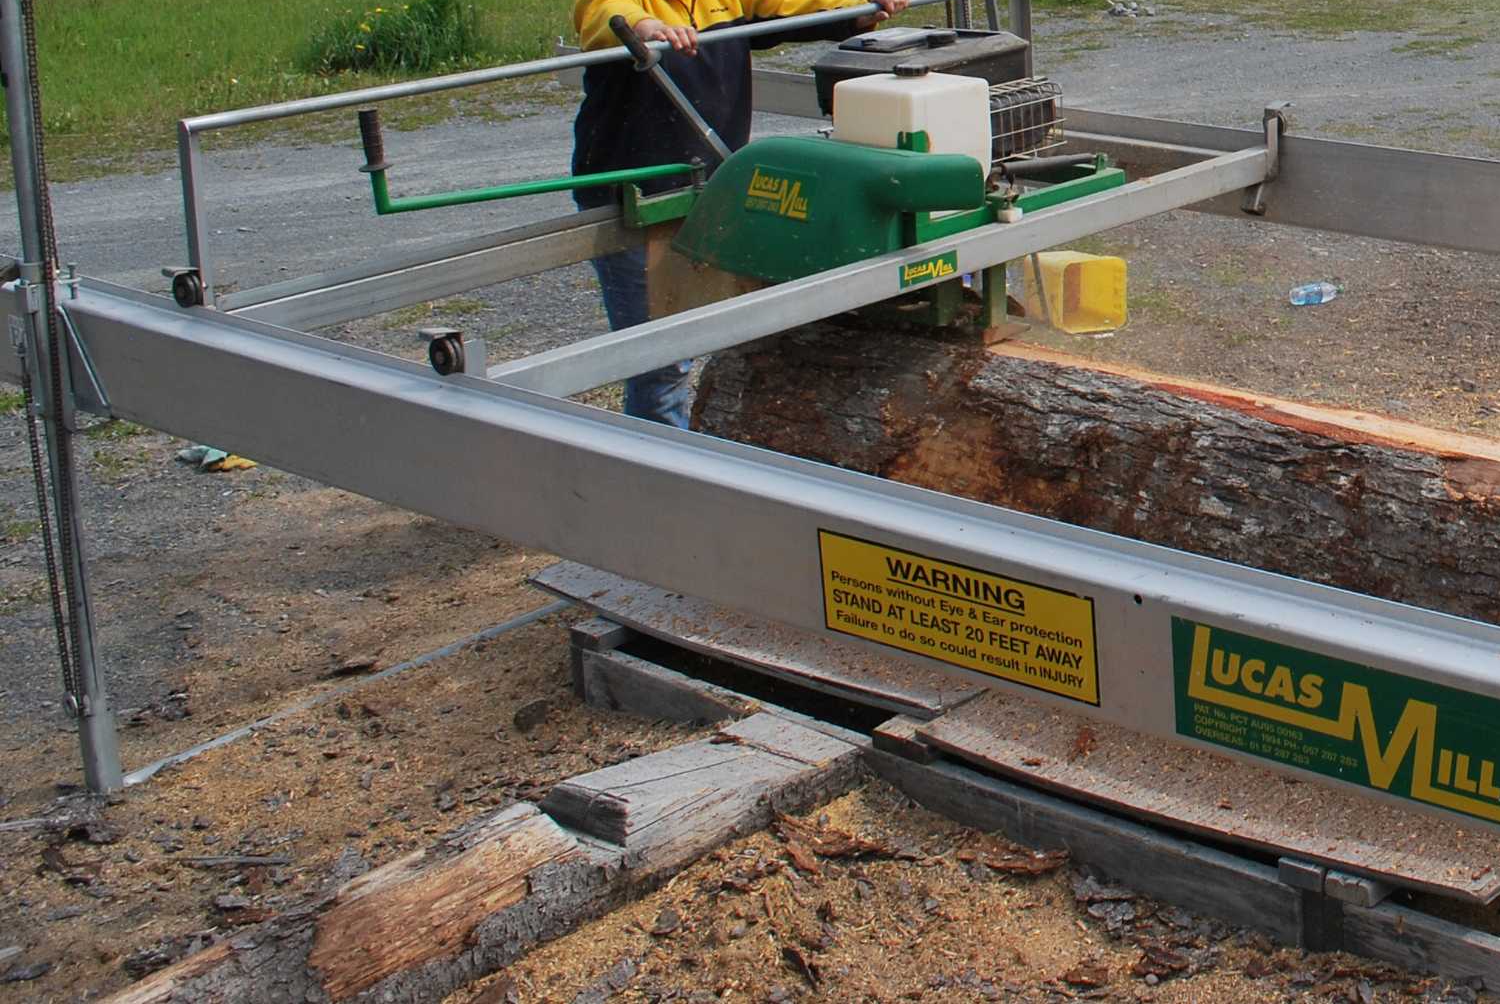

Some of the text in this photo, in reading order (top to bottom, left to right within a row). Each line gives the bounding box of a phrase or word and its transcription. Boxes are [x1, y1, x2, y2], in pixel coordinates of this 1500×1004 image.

[831, 570, 1083, 649] Persons without Eye & Ear protection
[886, 557, 1025, 611] WARNING
[832, 589, 1083, 670] STAND AT LEAST 20 FEET AWAY
[836, 609, 1084, 689] Failure to do so could result in INJURY
[1187, 624, 1350, 738] LUCAS
[1194, 714, 1247, 735] COPYRIGHT
